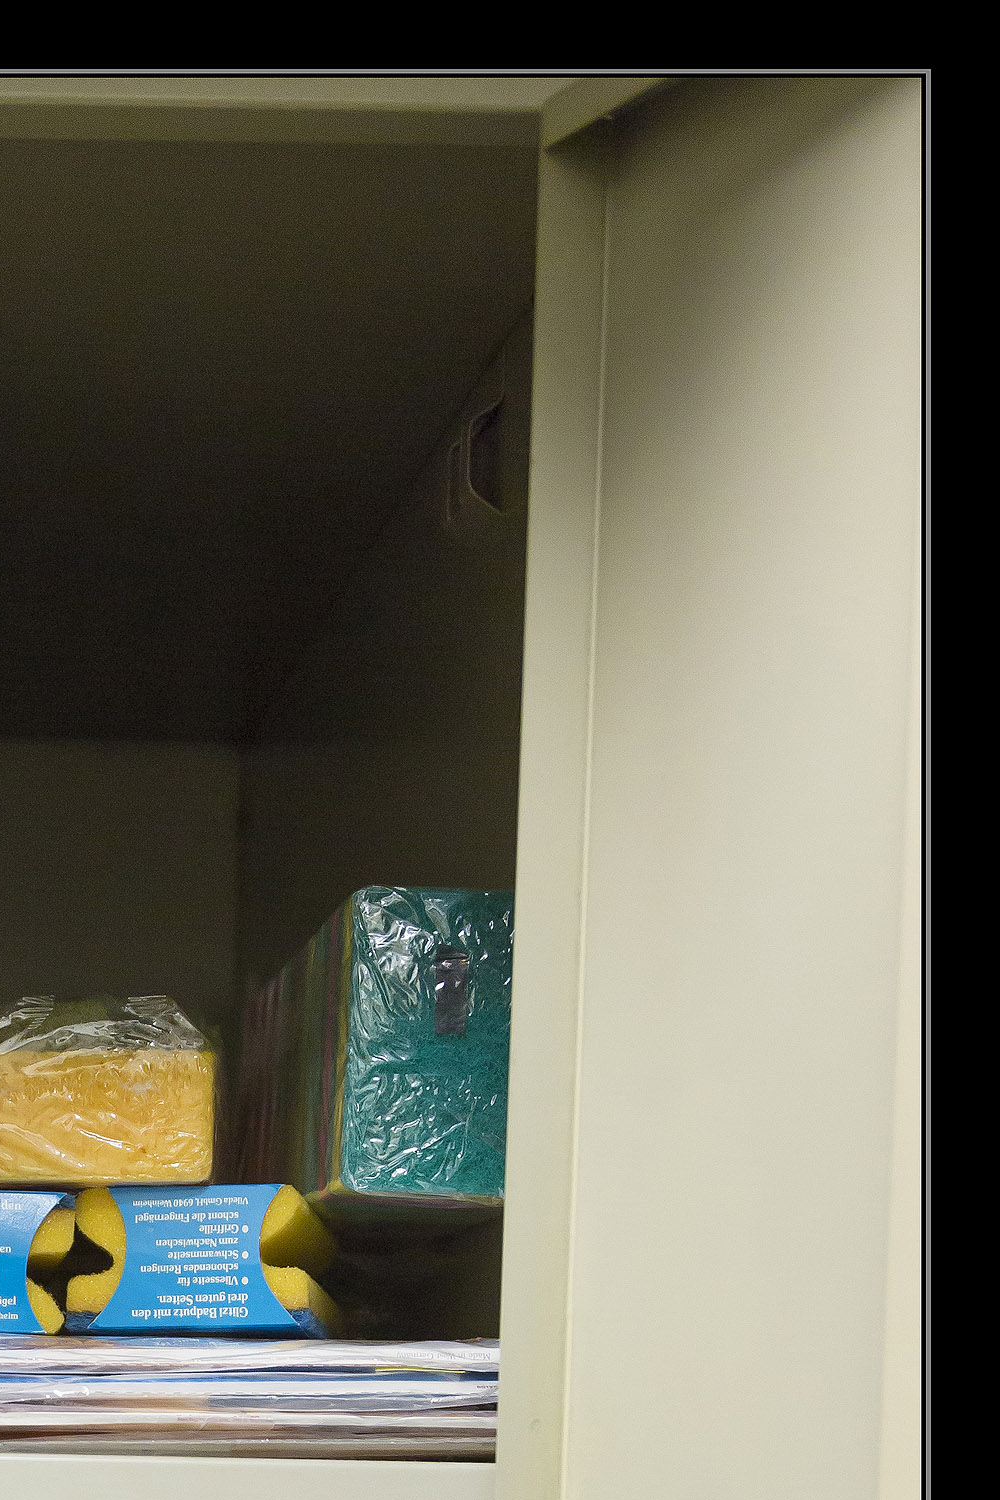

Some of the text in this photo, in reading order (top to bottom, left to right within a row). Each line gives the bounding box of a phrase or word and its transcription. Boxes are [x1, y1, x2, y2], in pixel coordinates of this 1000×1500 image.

[1, 1200, 21, 1210] den
[191, 1212, 206, 1222] die
[208, 1211, 239, 1221] schont
[156, 1238, 217, 1248] Nachwischen
[167, 1249, 239, 1260] Schwammseite
[140, 1263, 239, 1274] schonendes Reinigen
[176, 1275, 239, 1287] Vliesseite für
[195, 1291, 226, 1304] guten
[227, 1293, 249, 1304] drei
[131, 1306, 249, 1320] Glitzi Badputz mit den
